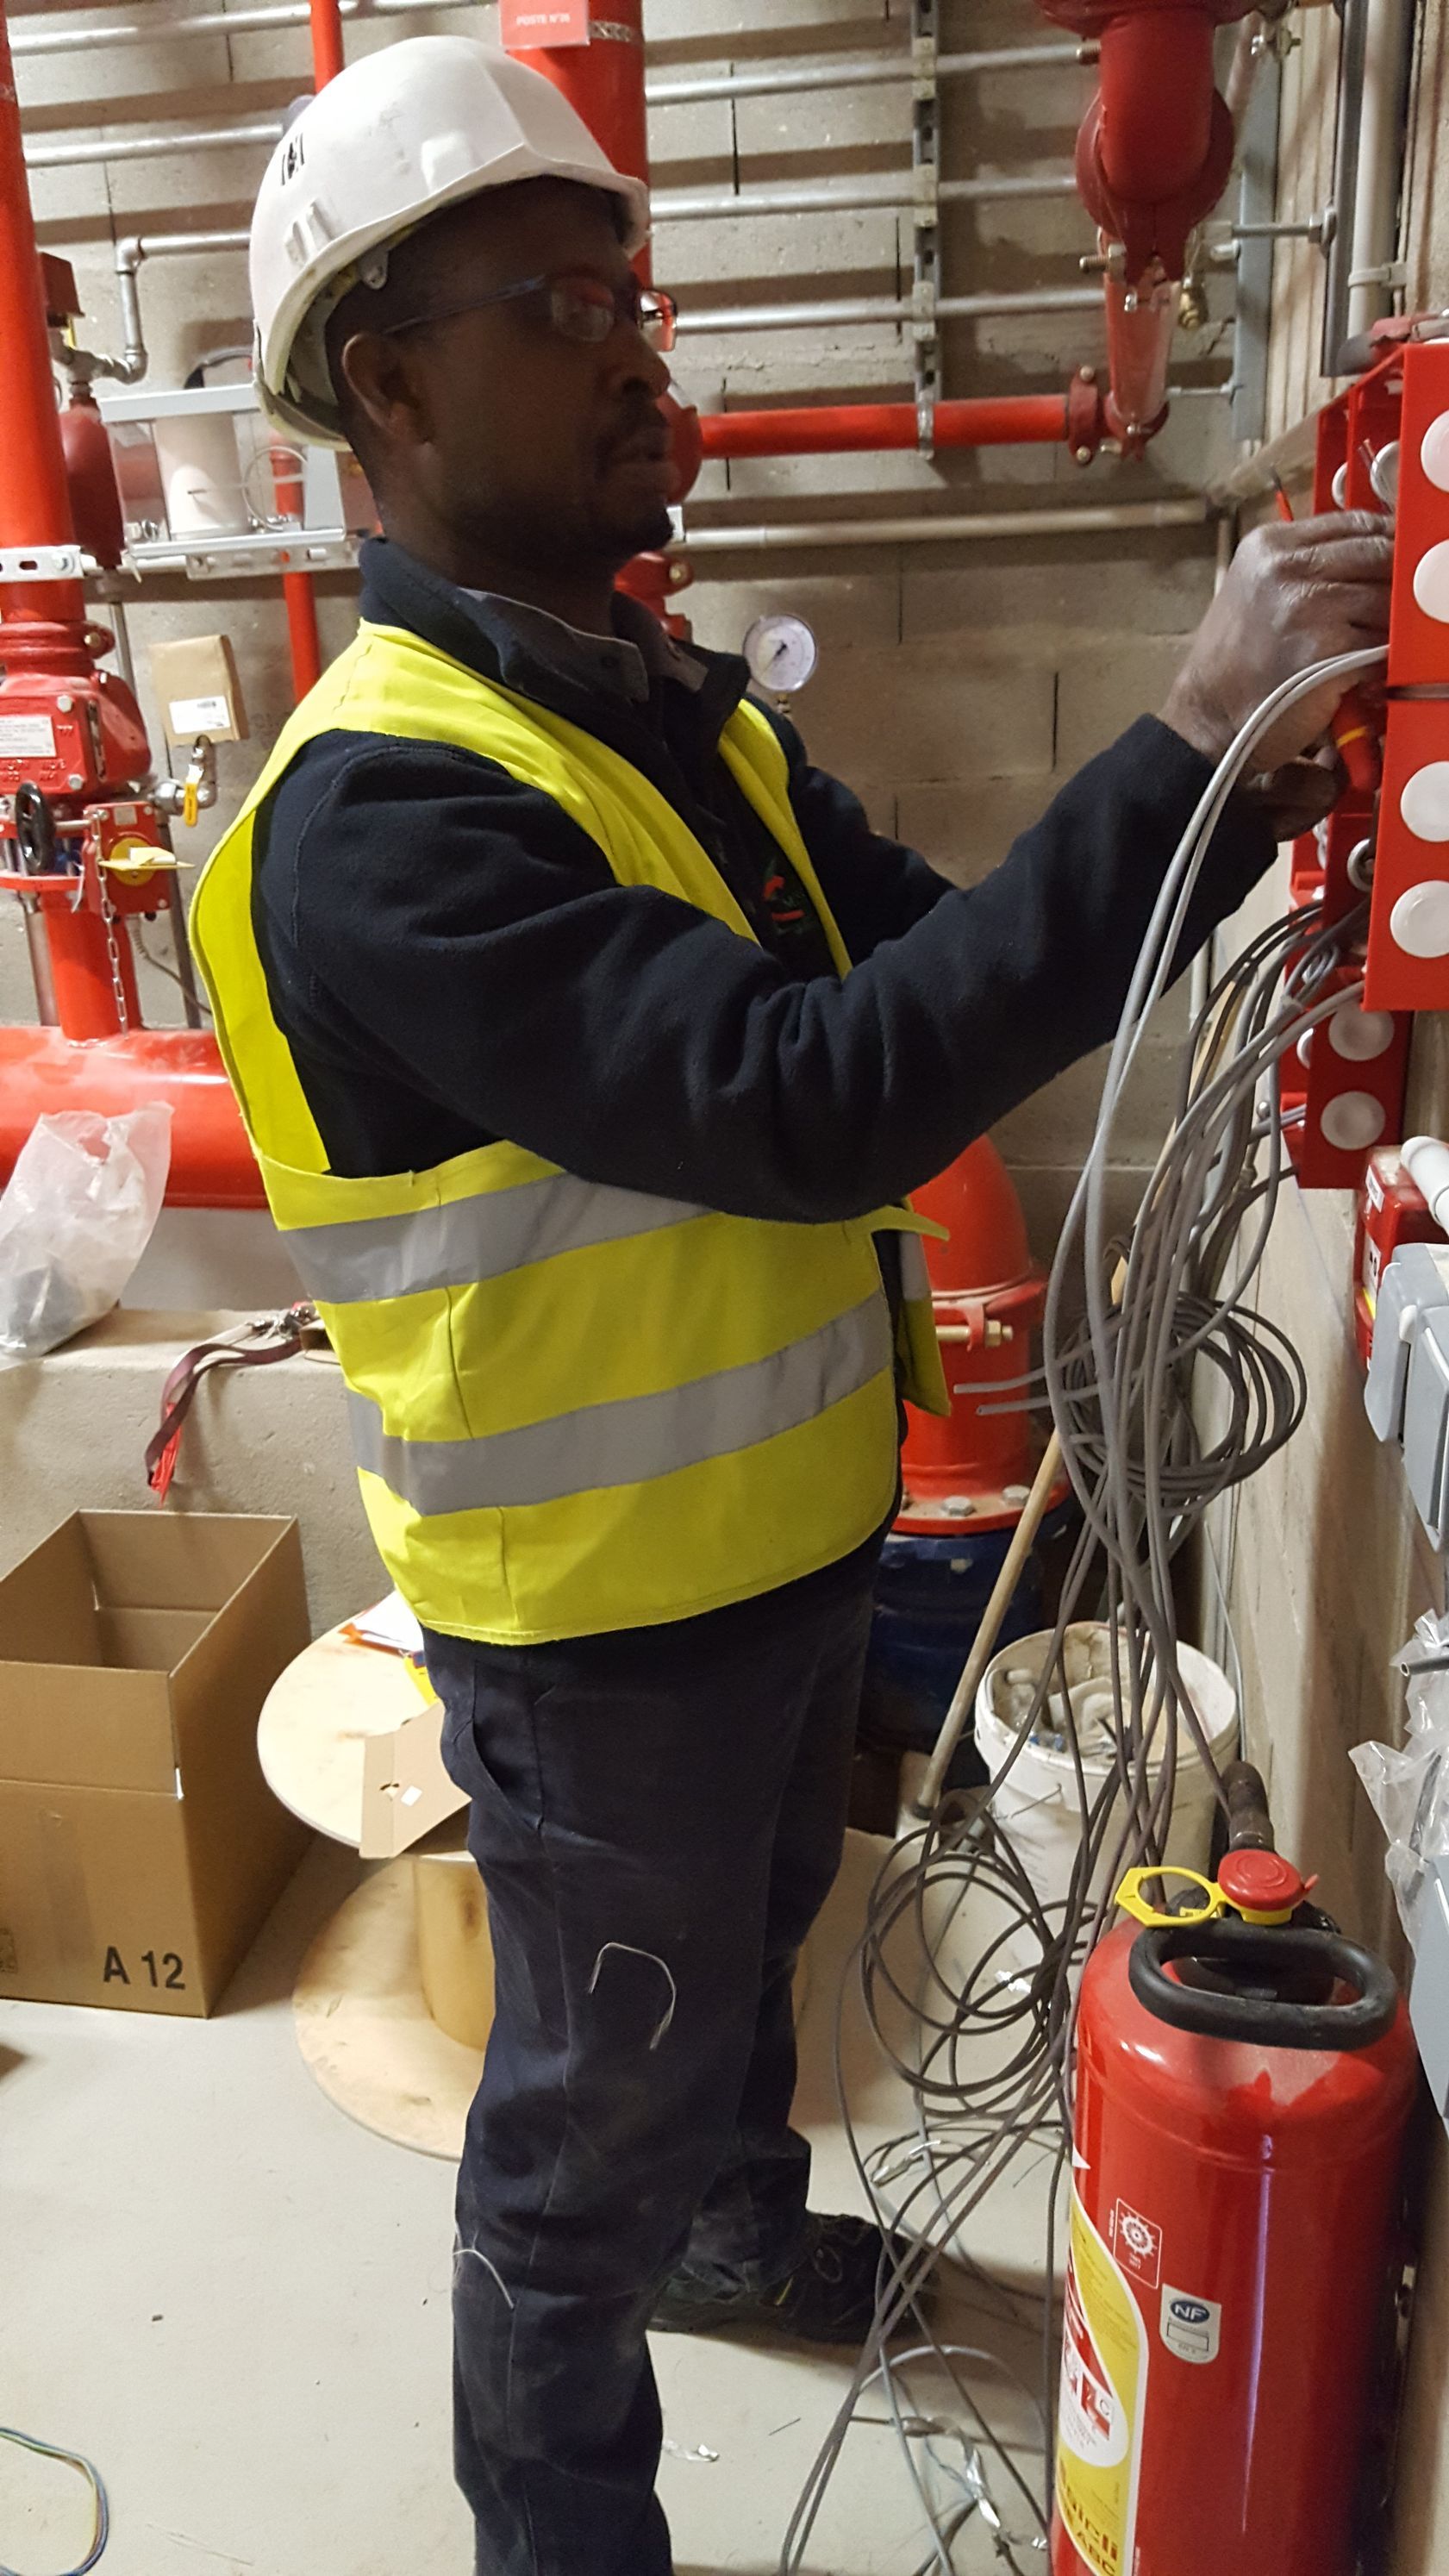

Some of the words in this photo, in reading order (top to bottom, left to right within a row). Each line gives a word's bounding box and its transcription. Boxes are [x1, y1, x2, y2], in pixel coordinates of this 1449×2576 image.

[516, 14, 546, 27] POSTE
[103, 1945, 131, 1985] A
[141, 1950, 186, 1990] 12
[1173, 2304, 1207, 2321] NF
